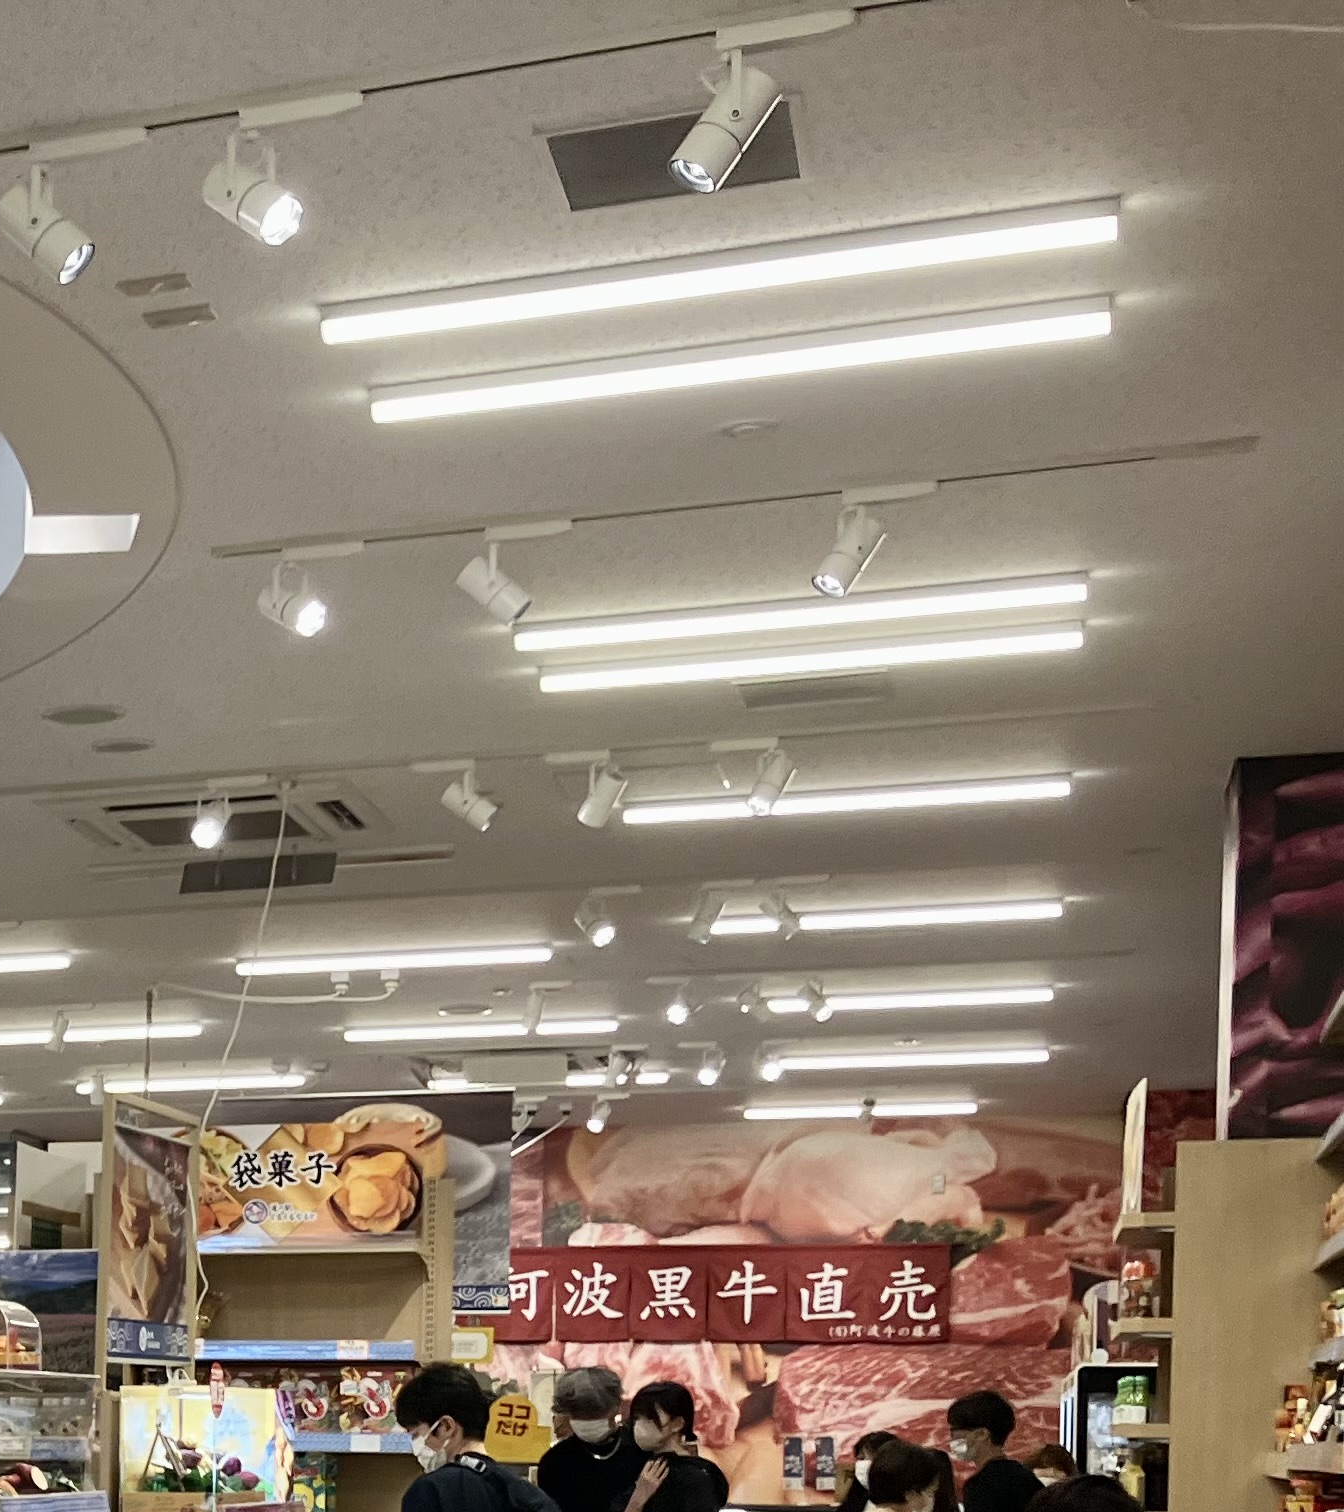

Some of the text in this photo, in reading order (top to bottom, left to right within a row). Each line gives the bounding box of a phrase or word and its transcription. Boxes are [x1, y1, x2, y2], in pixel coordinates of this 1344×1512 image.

[229, 1151, 337, 1190] 袋菓子
[496, 1401, 531, 1418] ココ
[496, 1420, 530, 1436] だけ
